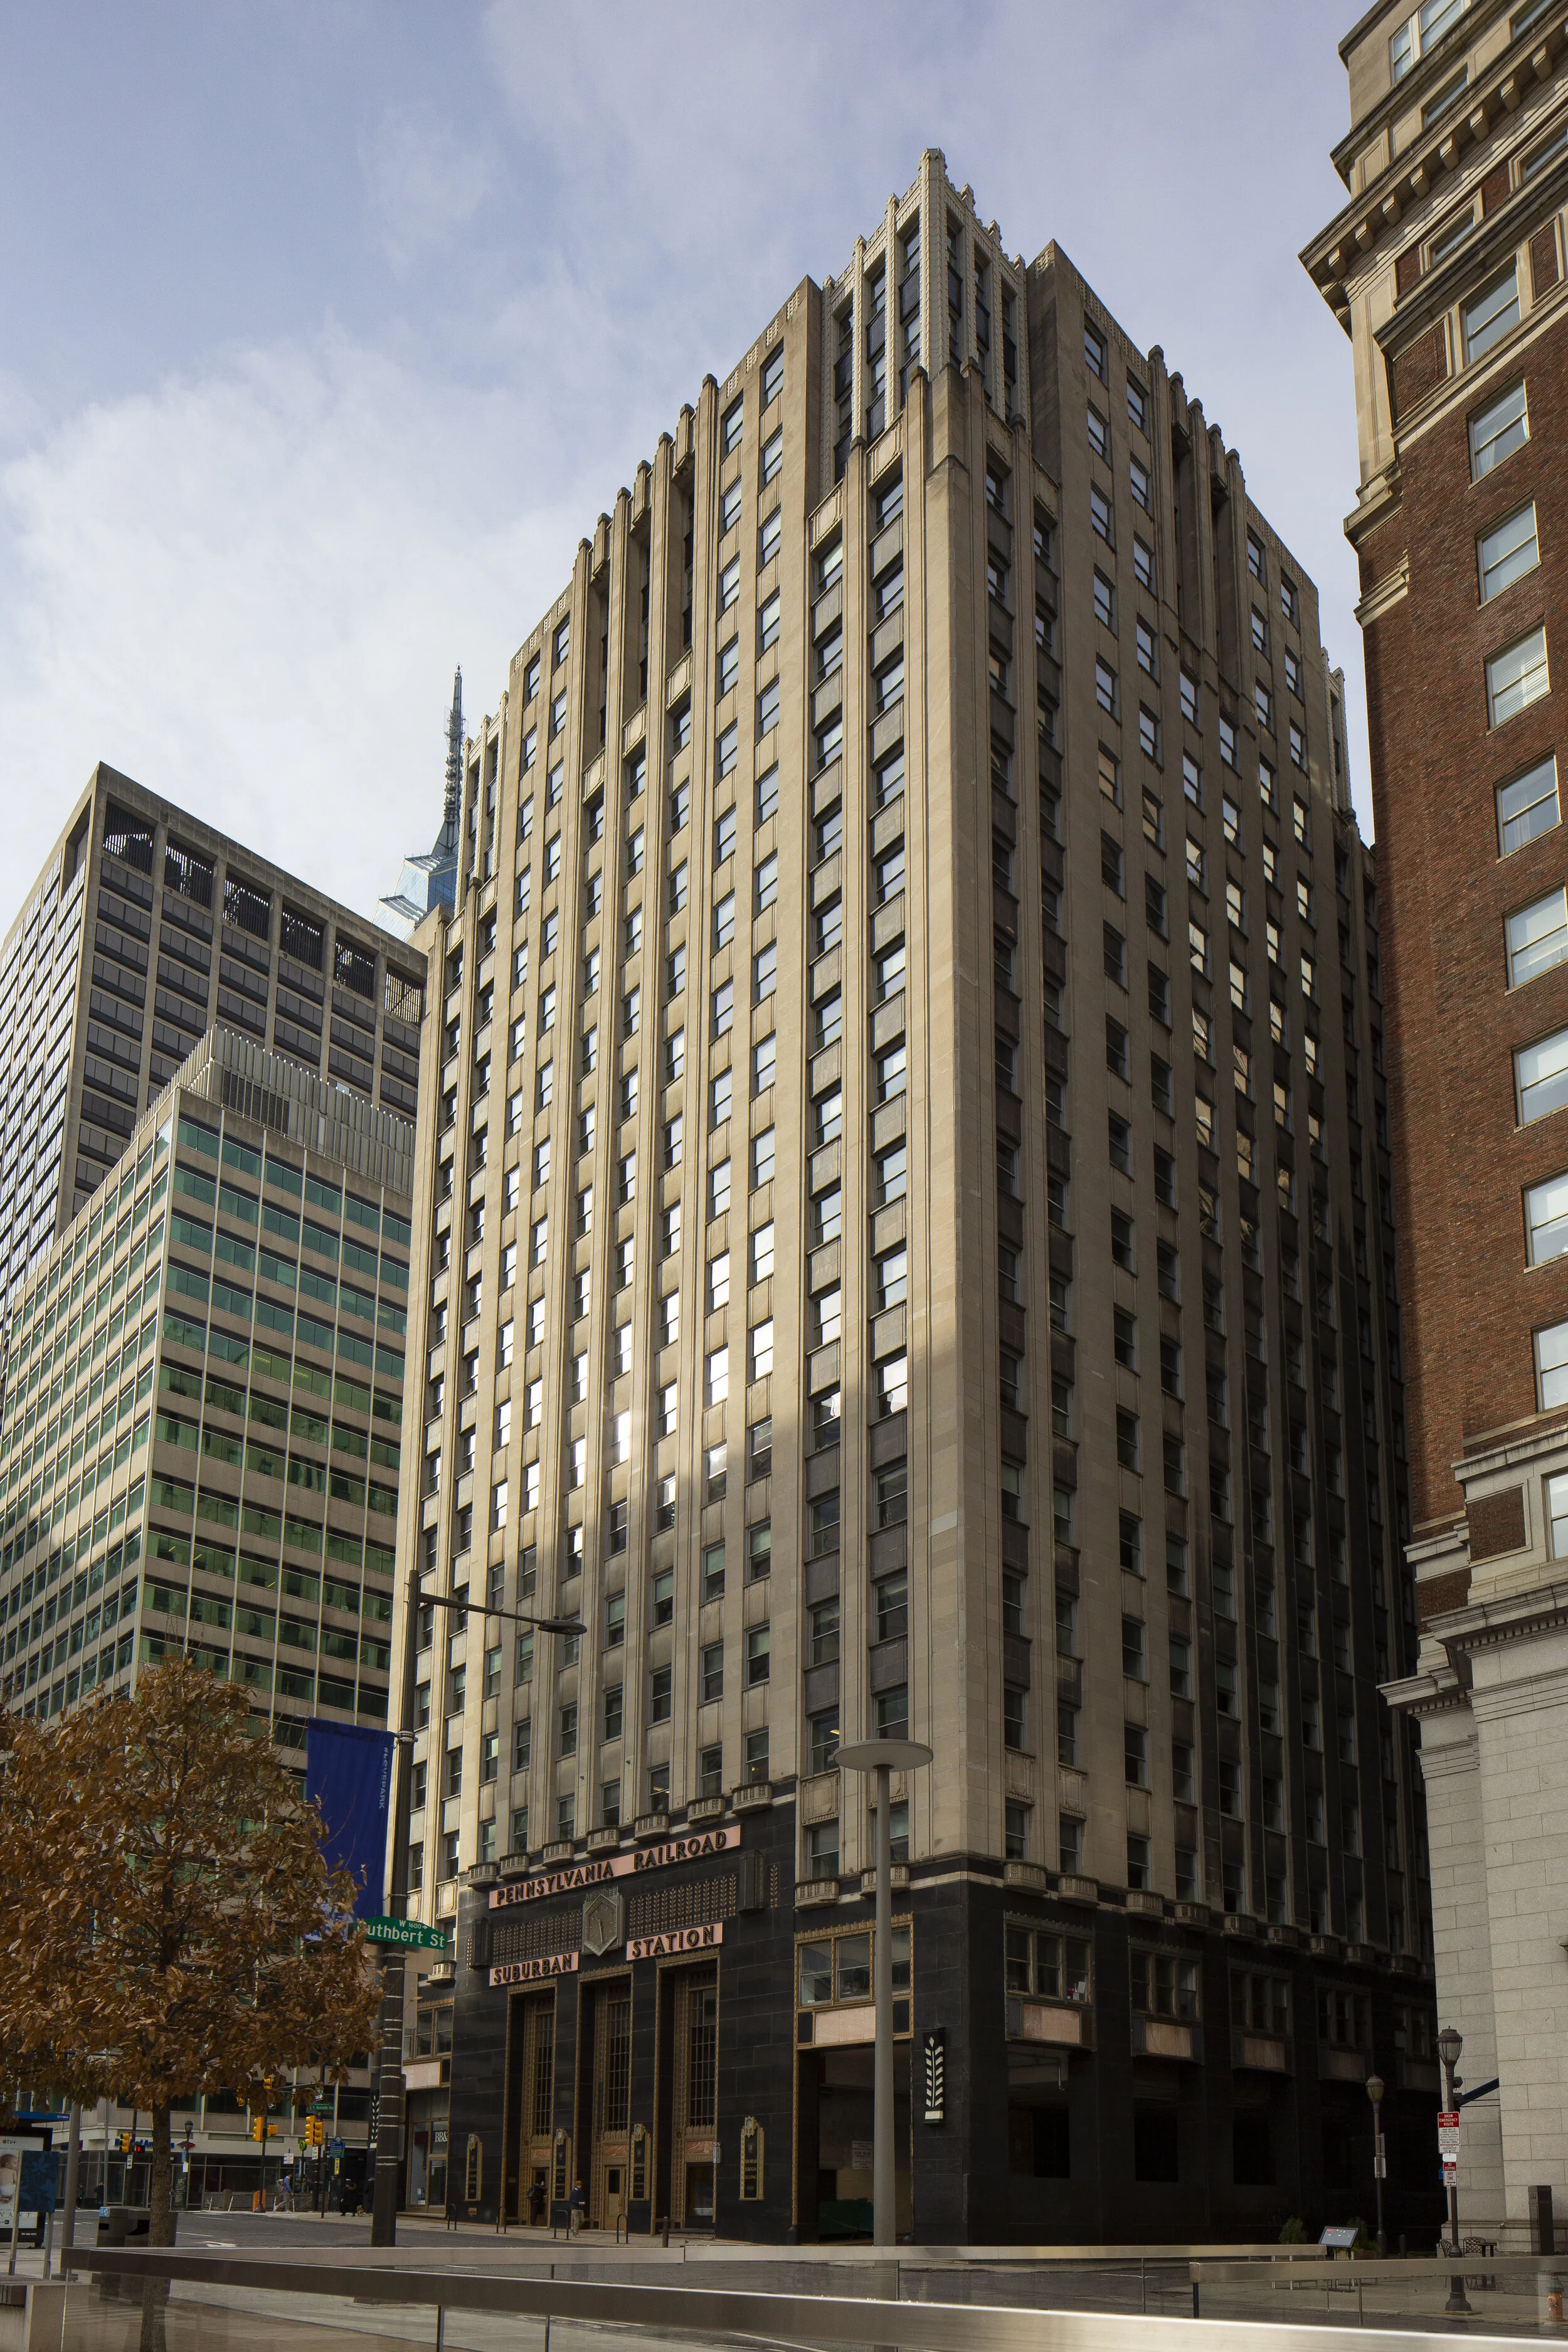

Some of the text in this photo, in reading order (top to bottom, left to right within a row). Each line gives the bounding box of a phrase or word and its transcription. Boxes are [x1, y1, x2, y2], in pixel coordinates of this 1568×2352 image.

[497, 1831, 727, 1904] PENNSYLVANIA RAILROAD
[357, 1924, 445, 1947] uthbert St
[632, 1925, 714, 1958] STATION
[494, 1954, 571, 1984] SUBURBAN
